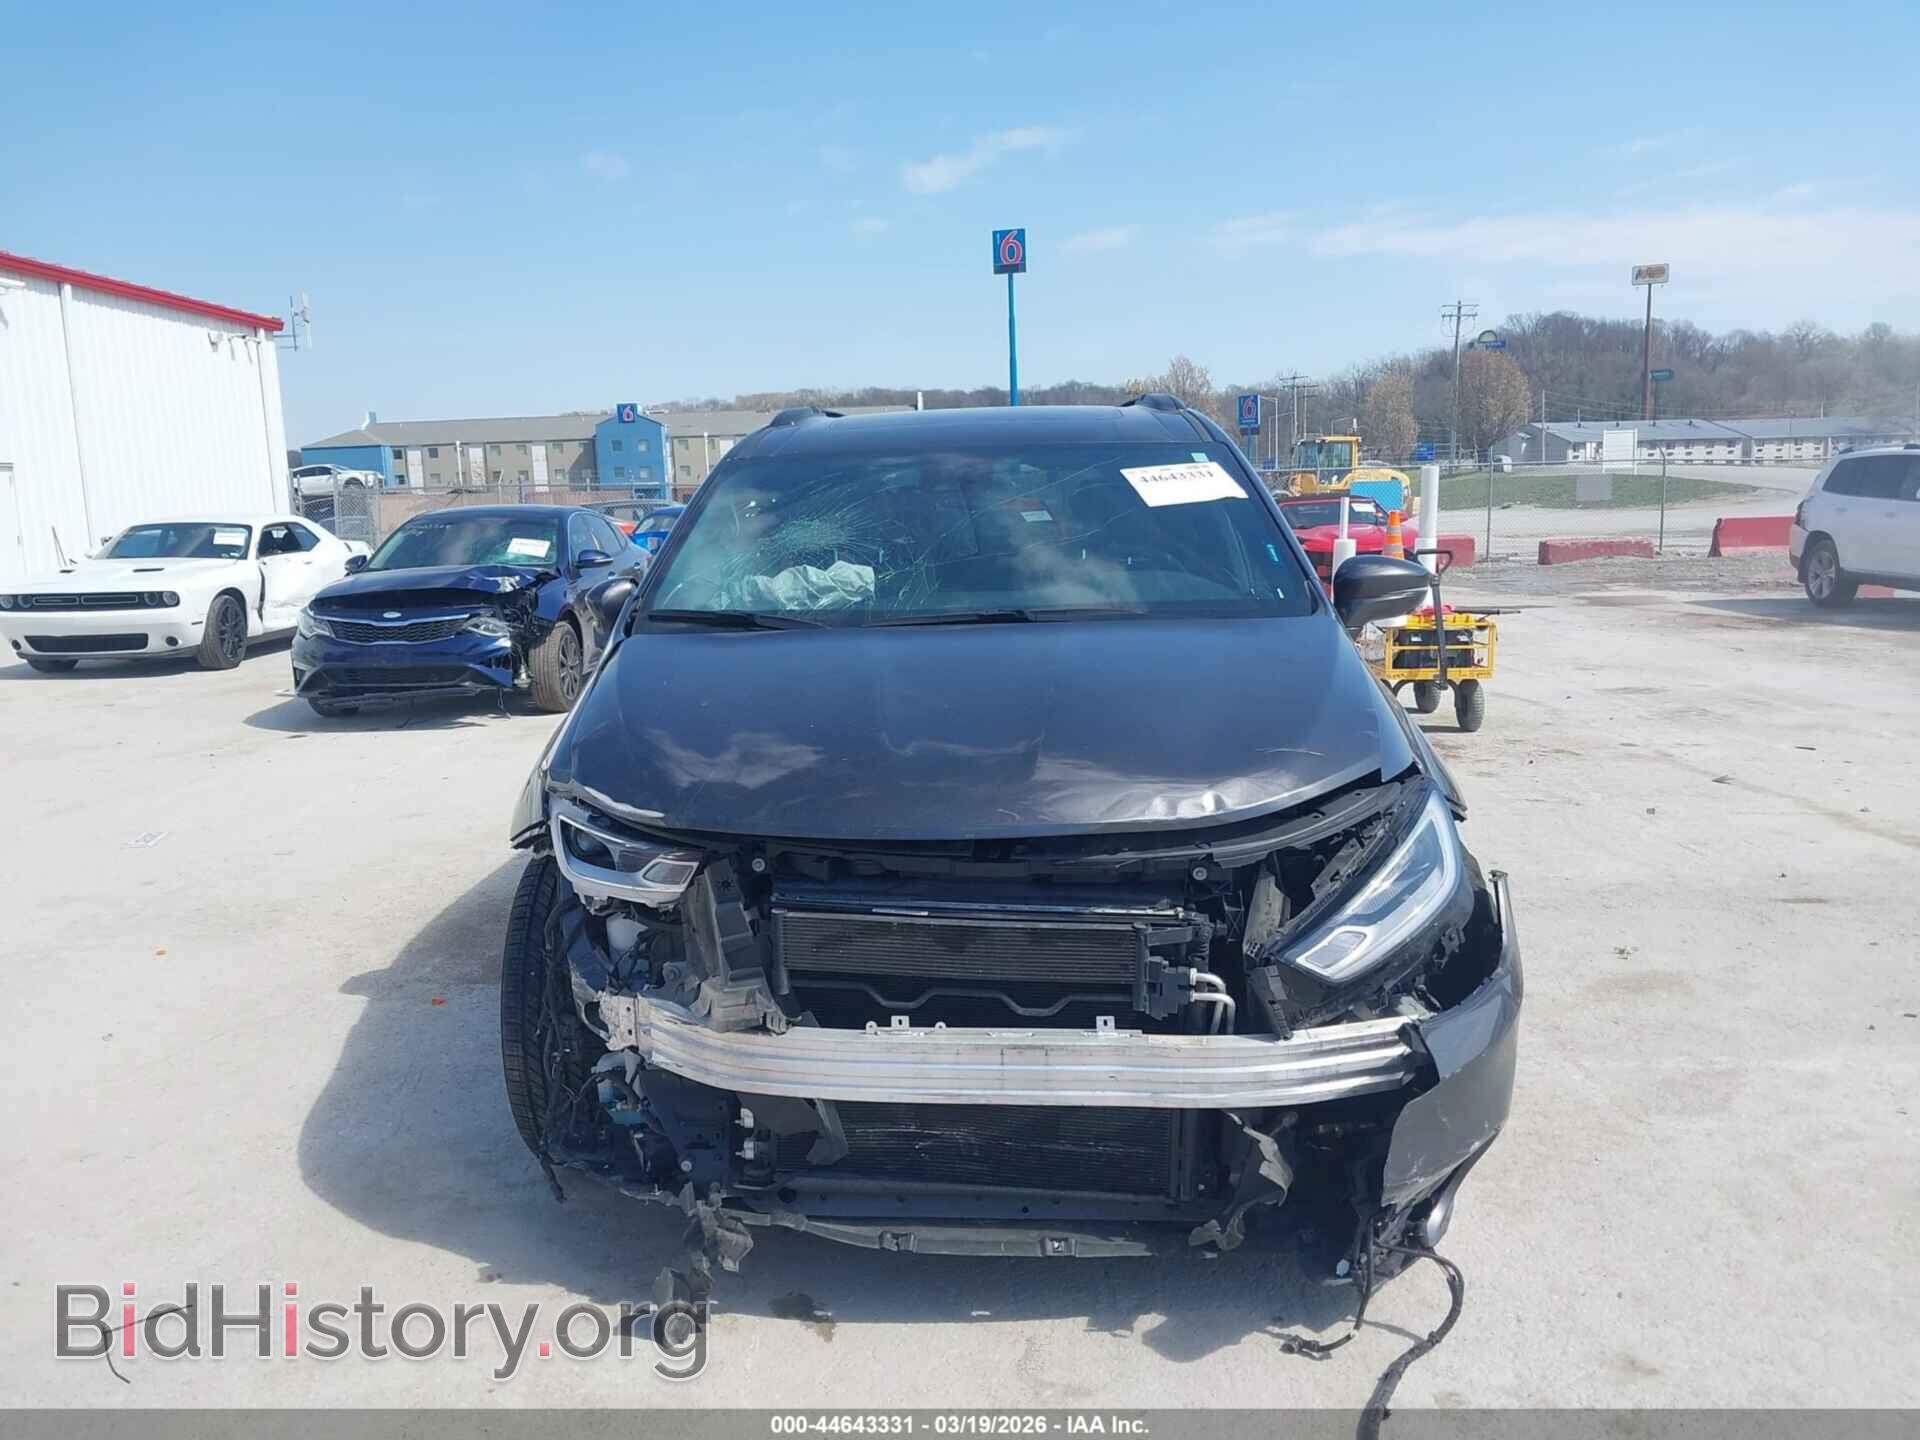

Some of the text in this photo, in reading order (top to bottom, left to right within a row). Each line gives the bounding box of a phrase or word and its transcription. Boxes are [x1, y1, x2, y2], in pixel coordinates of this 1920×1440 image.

[1000, 230, 1022, 265] 6
[623, 406, 634, 421] 6
[1243, 398, 1256, 419] 6
